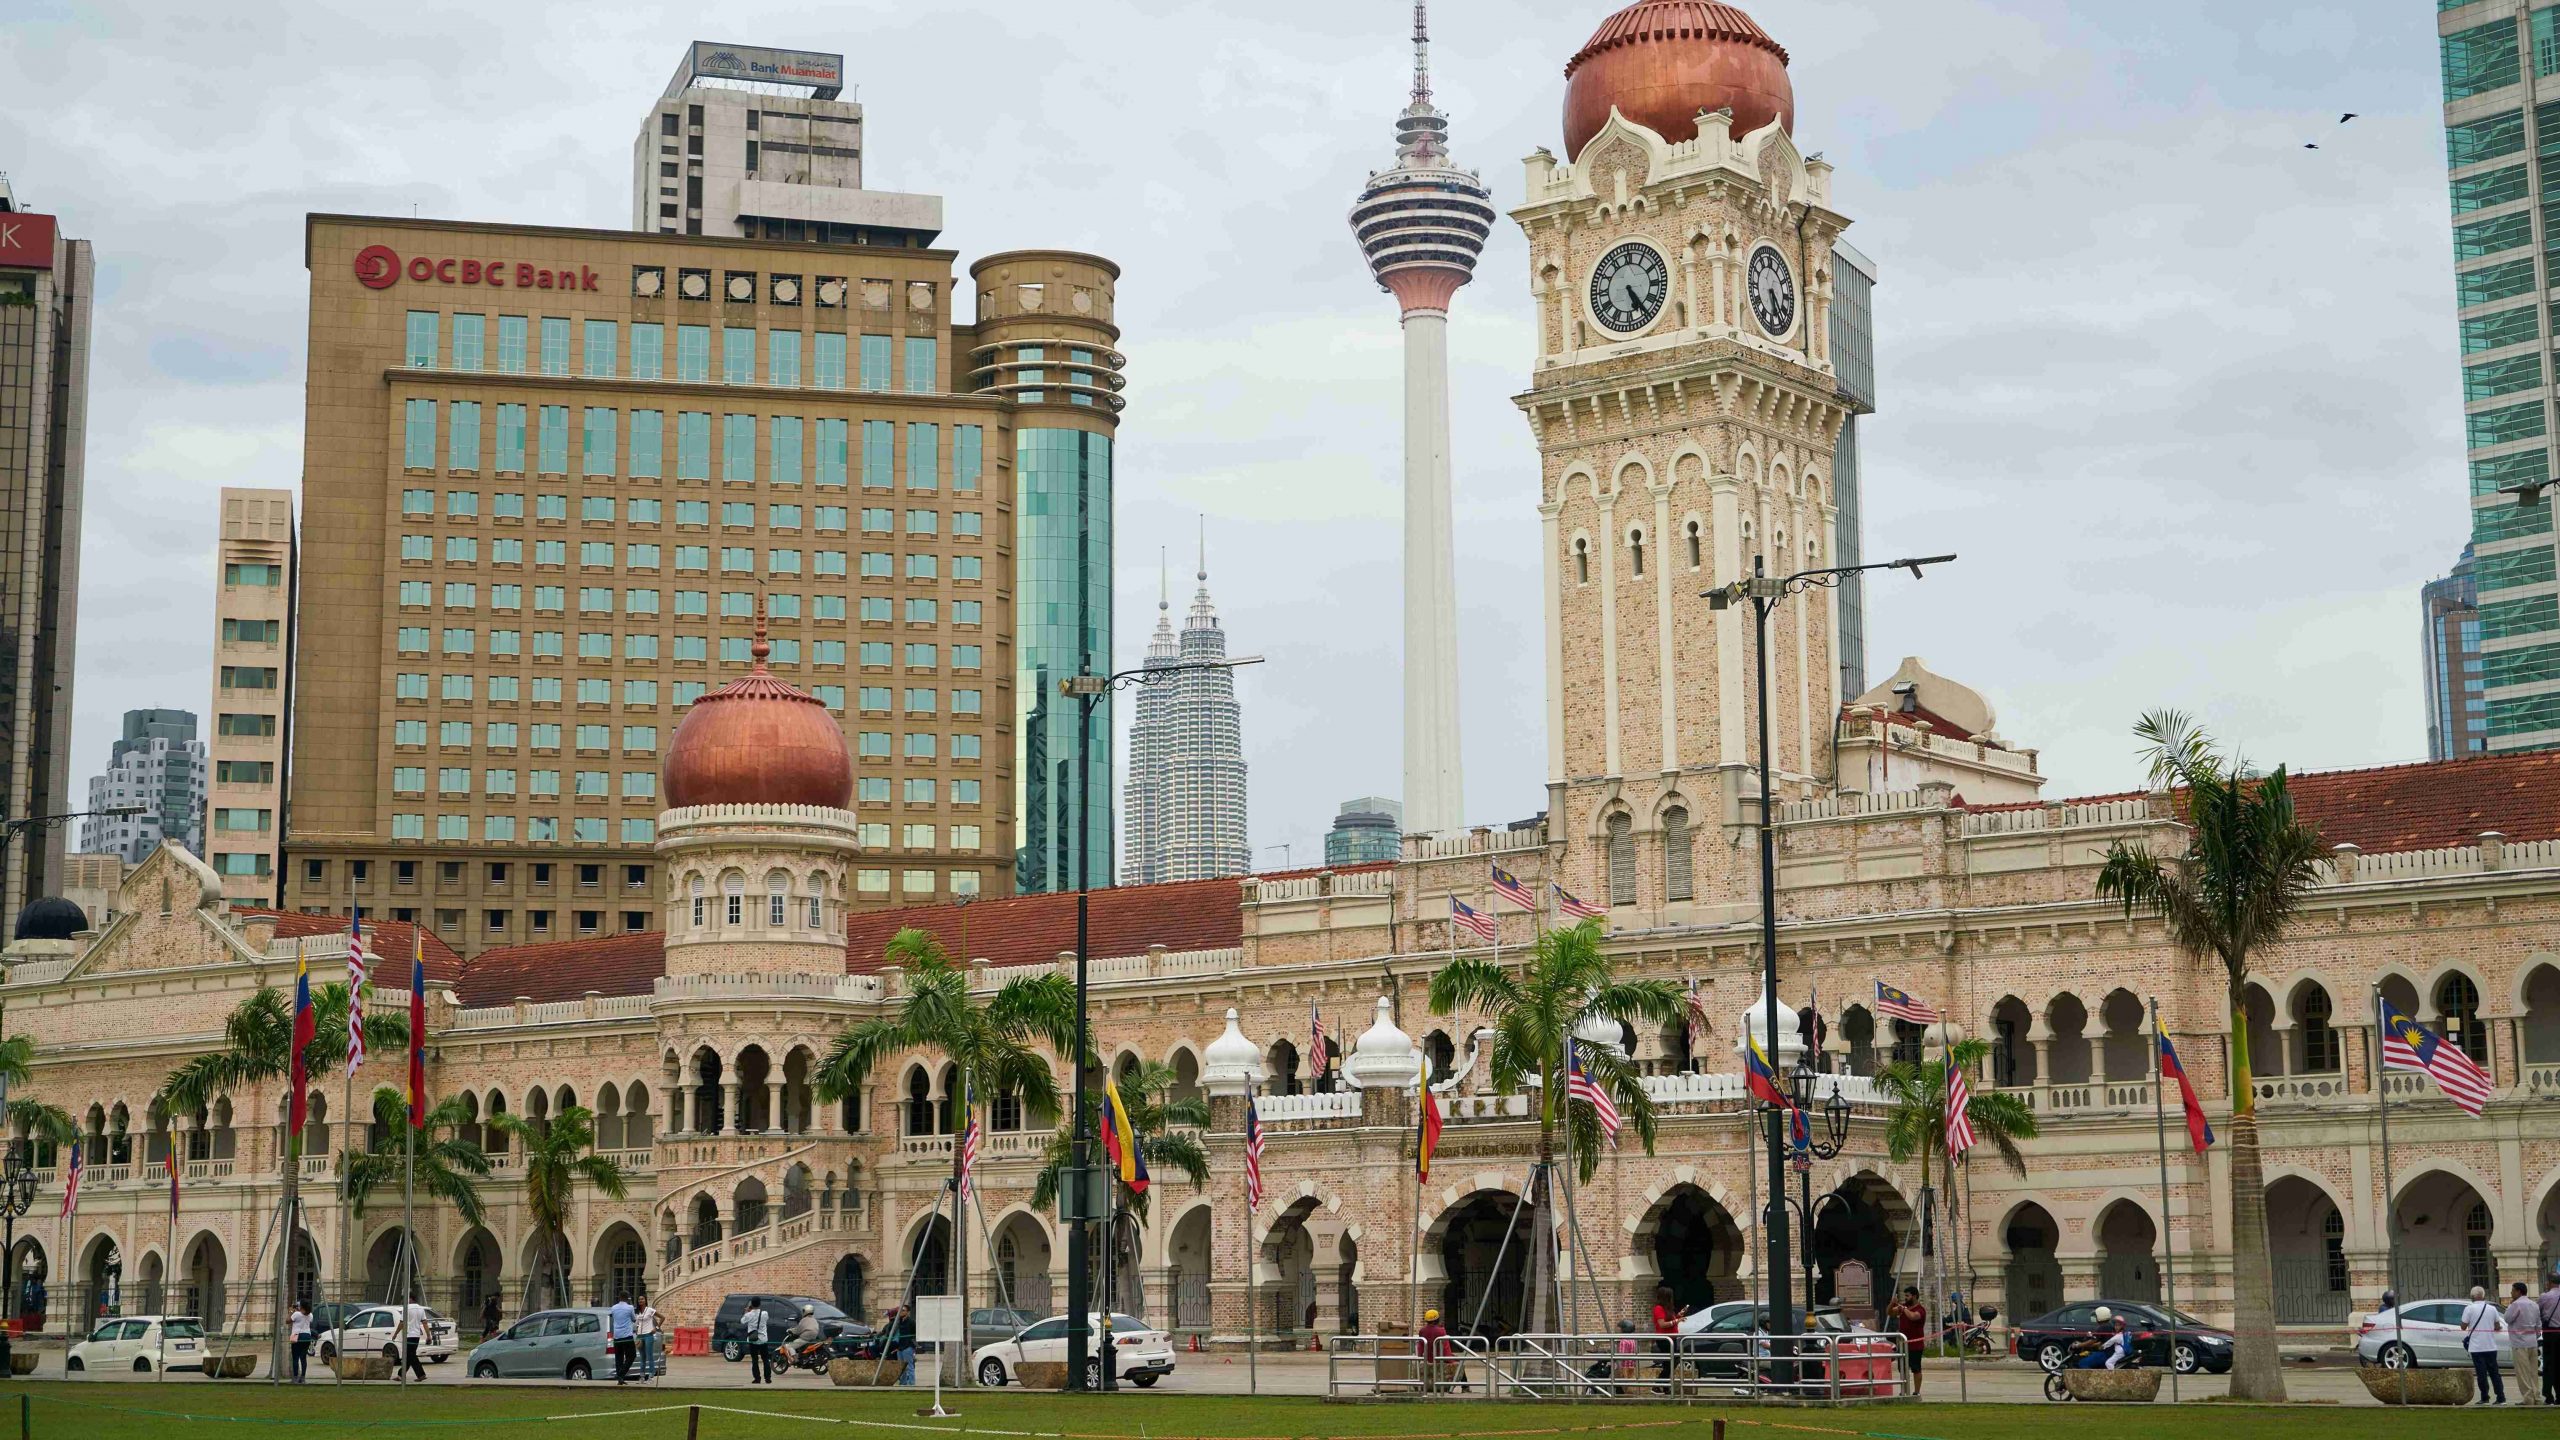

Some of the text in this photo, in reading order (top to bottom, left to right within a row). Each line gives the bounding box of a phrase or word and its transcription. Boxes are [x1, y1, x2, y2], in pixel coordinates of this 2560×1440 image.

[751, 61, 779, 74] Bank
[780, 64, 837, 79] Muamalat
[2, 222, 22, 249] K
[408, 256, 599, 291] OCBC Bank
